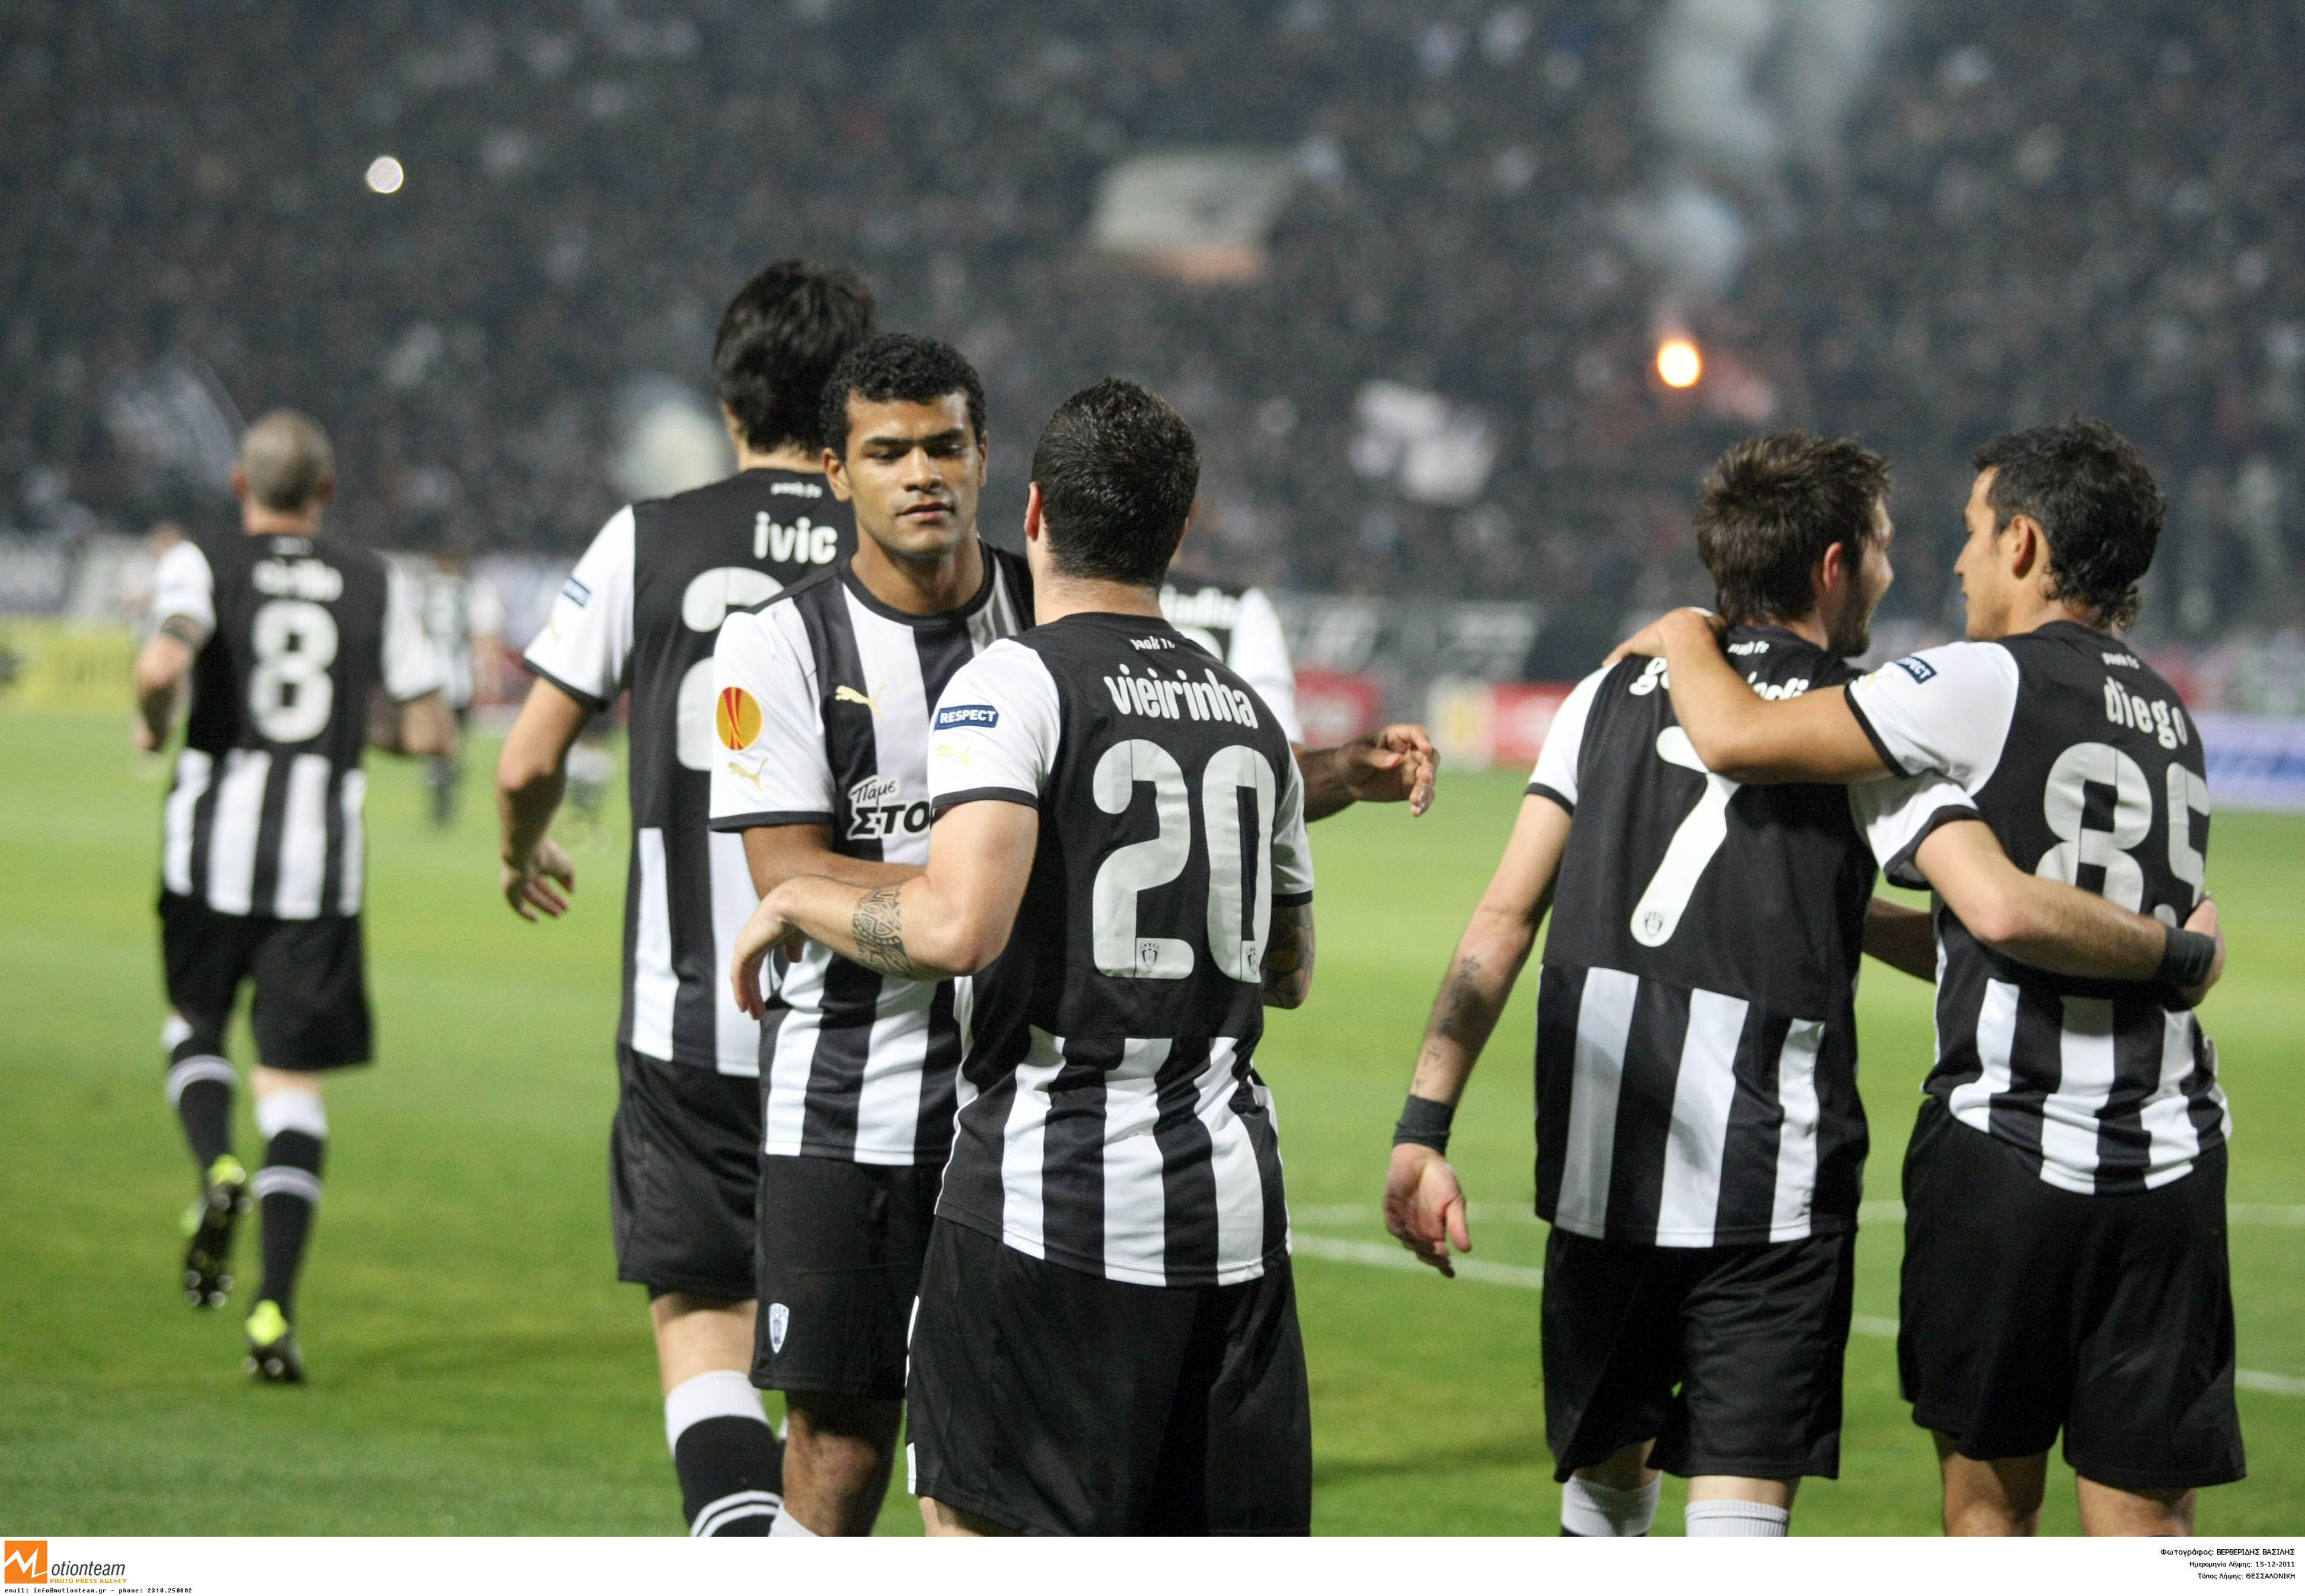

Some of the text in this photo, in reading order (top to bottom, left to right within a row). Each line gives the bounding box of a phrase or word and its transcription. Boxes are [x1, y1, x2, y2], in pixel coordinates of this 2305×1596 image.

[754, 510, 838, 564] ivic
[248, 598, 339, 743] 8
[940, 709, 997, 724] RESPECT
[1103, 663, 1258, 729] vieirinha
[2103, 675, 2188, 749] diego
[1093, 739, 1276, 984] 20
[1630, 726, 1741, 947] 7
[2035, 742, 2210, 928] 85
